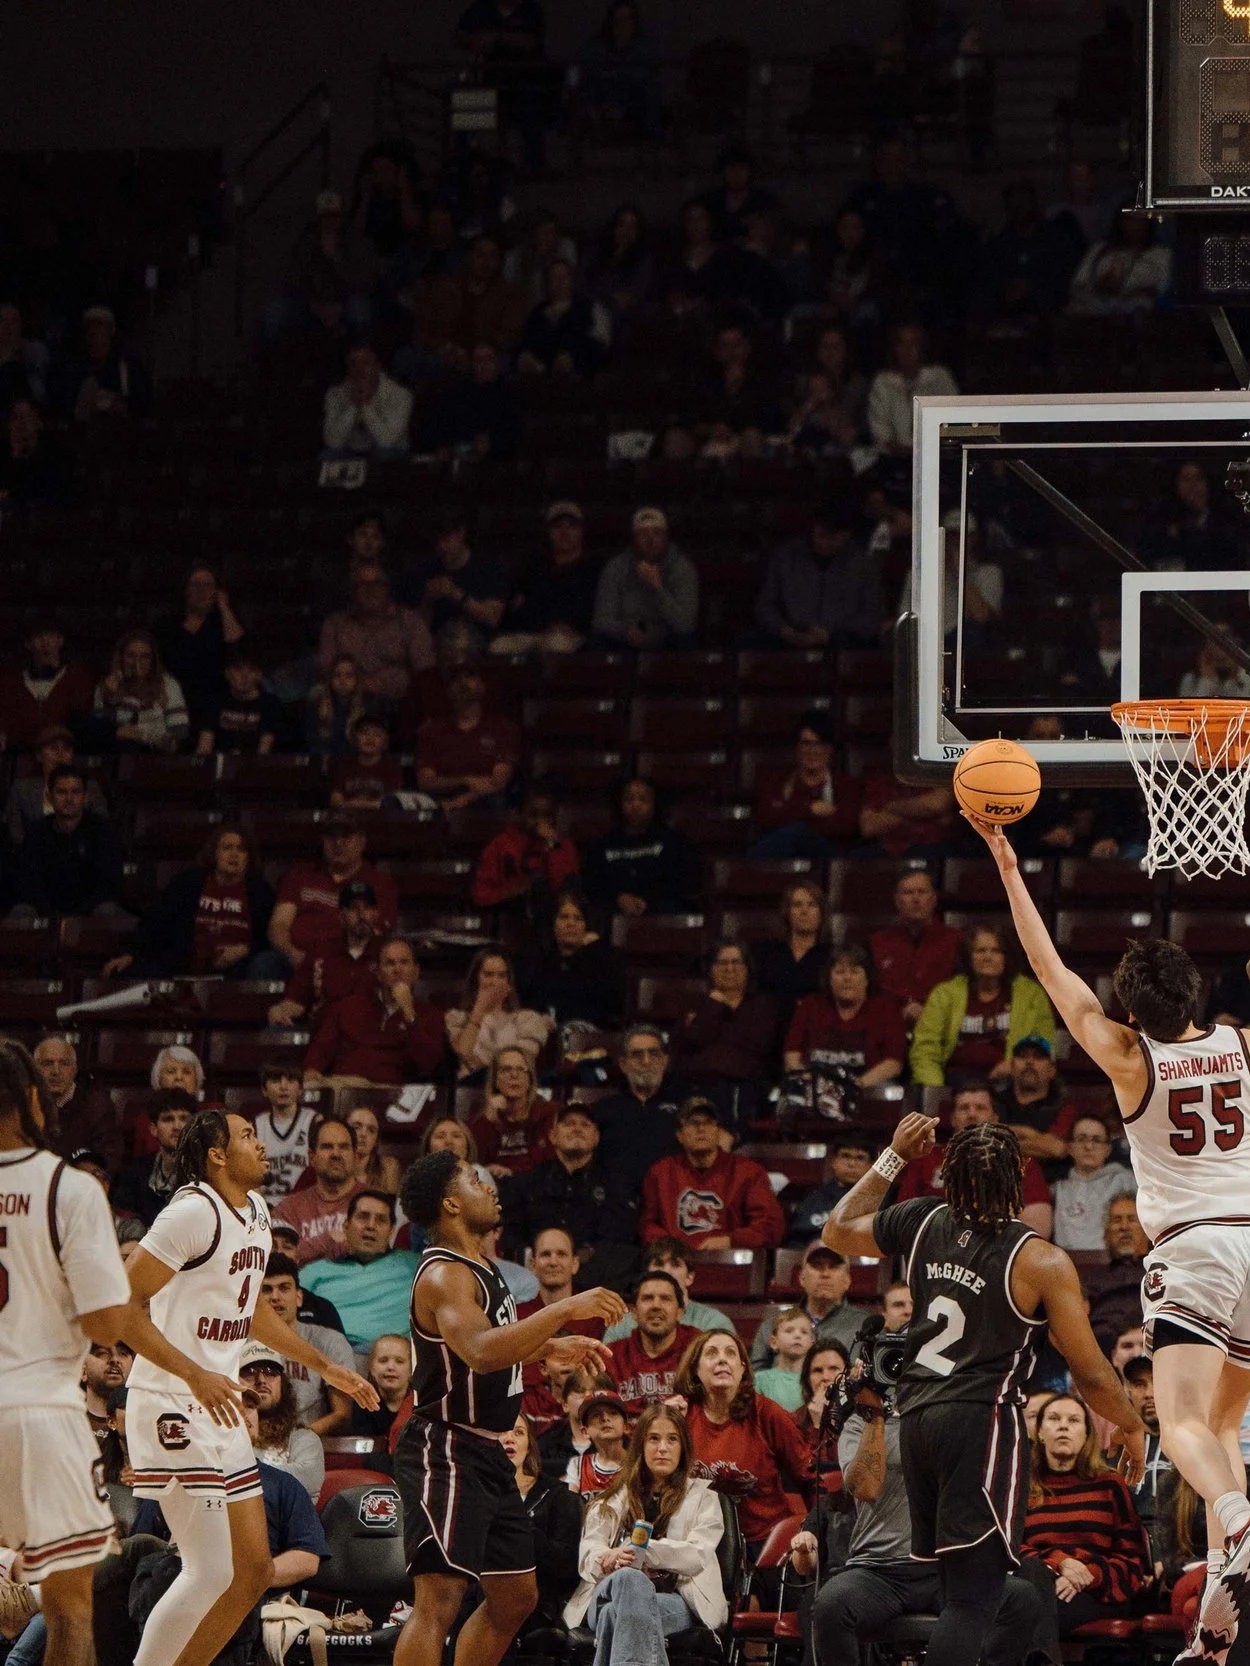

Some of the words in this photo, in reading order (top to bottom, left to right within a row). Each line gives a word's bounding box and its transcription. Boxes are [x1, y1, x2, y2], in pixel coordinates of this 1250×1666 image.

[943, 746, 969, 760] SPA
[985, 803, 1025, 816] NCAA
[1168, 1079, 1245, 1156] 55
[228, 1245, 266, 1276] SOUTH
[237, 1274, 252, 1314] 4
[925, 1262, 988, 1296] McGHEE
[196, 1314, 252, 1342] CAROLIN
[914, 1294, 967, 1377] 2
[297, 1634, 373, 1646] GAECOCKS
